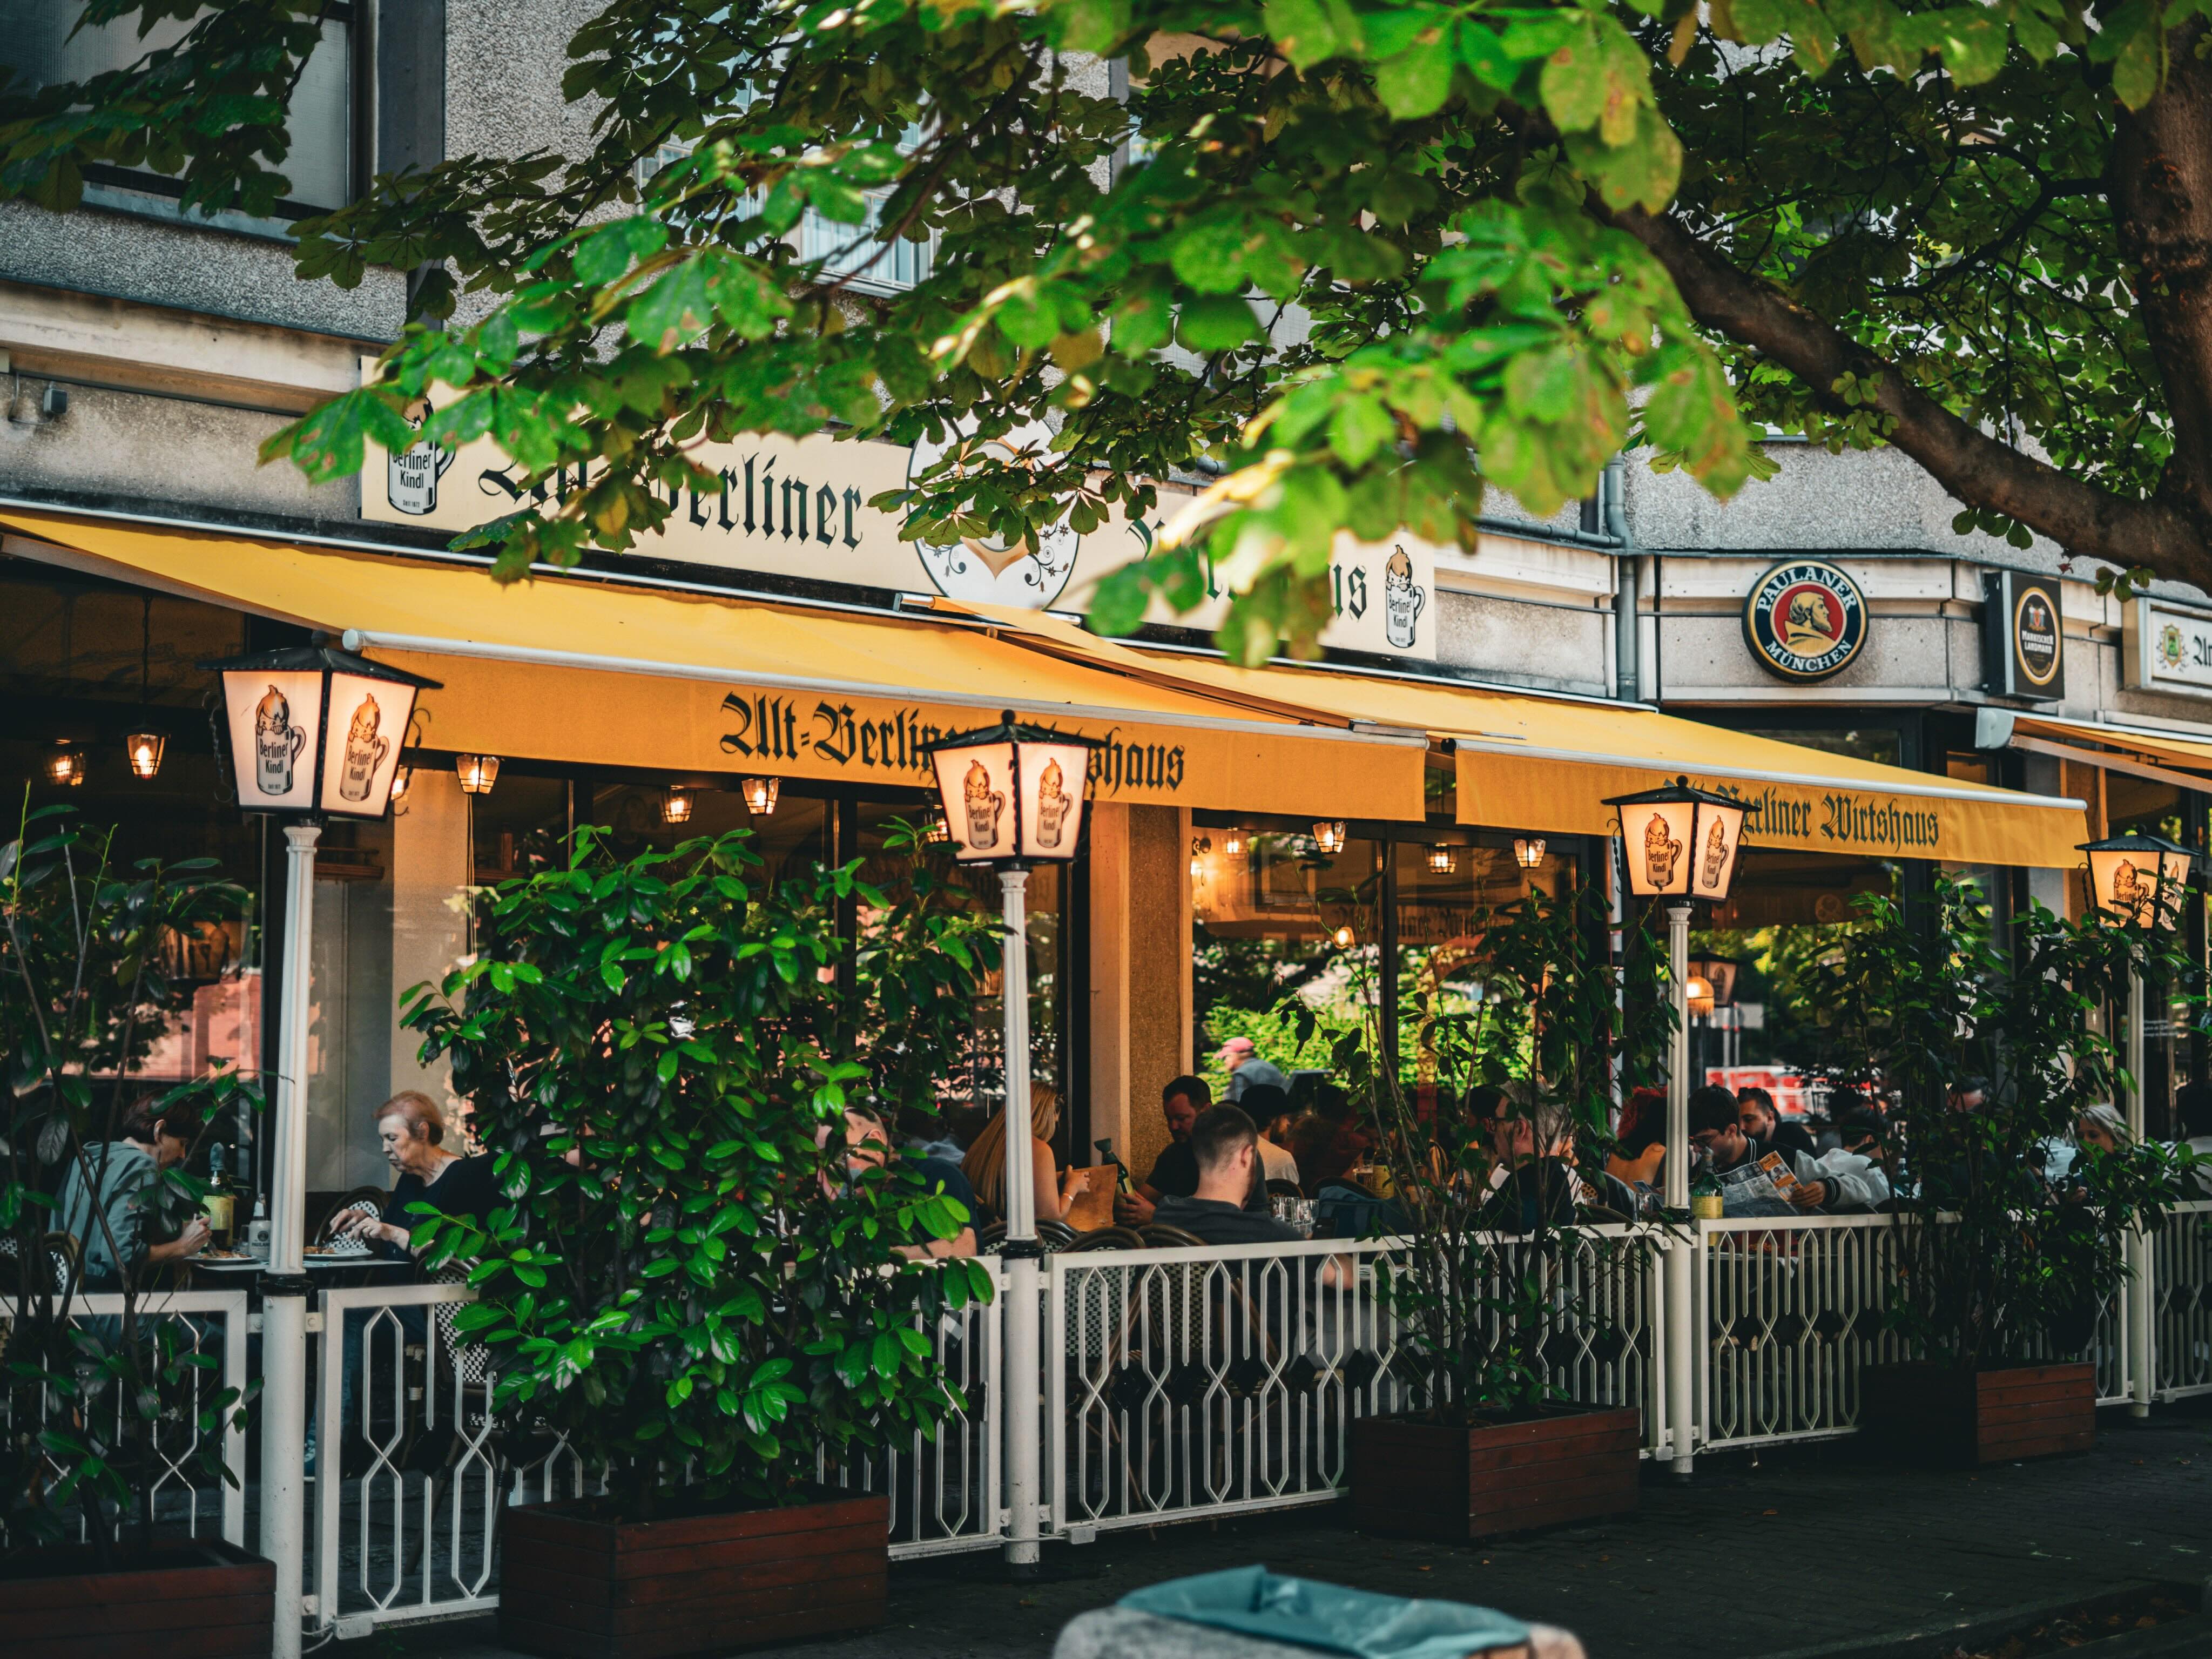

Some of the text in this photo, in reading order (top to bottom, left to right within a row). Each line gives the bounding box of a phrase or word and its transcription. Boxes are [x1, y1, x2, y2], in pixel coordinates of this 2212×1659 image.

[400, 469, 424, 489] Kindl
[1756, 567, 1858, 612] PAULANER
[1389, 594, 1412, 613] Berliner
[1394, 614, 1407, 628] Kindl
[1765, 640, 1853, 672] MÜNCHEN
[260, 738, 288, 758] Berliner
[348, 745, 373, 766] Berliner
[266, 759, 284, 773] Kindl
[349, 766, 366, 781] Kindl
[968, 805, 992, 819] Berliner
[1041, 801, 1060, 817] Berliner
[975, 820, 989, 832] Kindl
[1819, 793, 1940, 853] Wirtshaus
[1648, 849, 1669, 862] Berliner
[1653, 862, 1666, 873] Kindl
